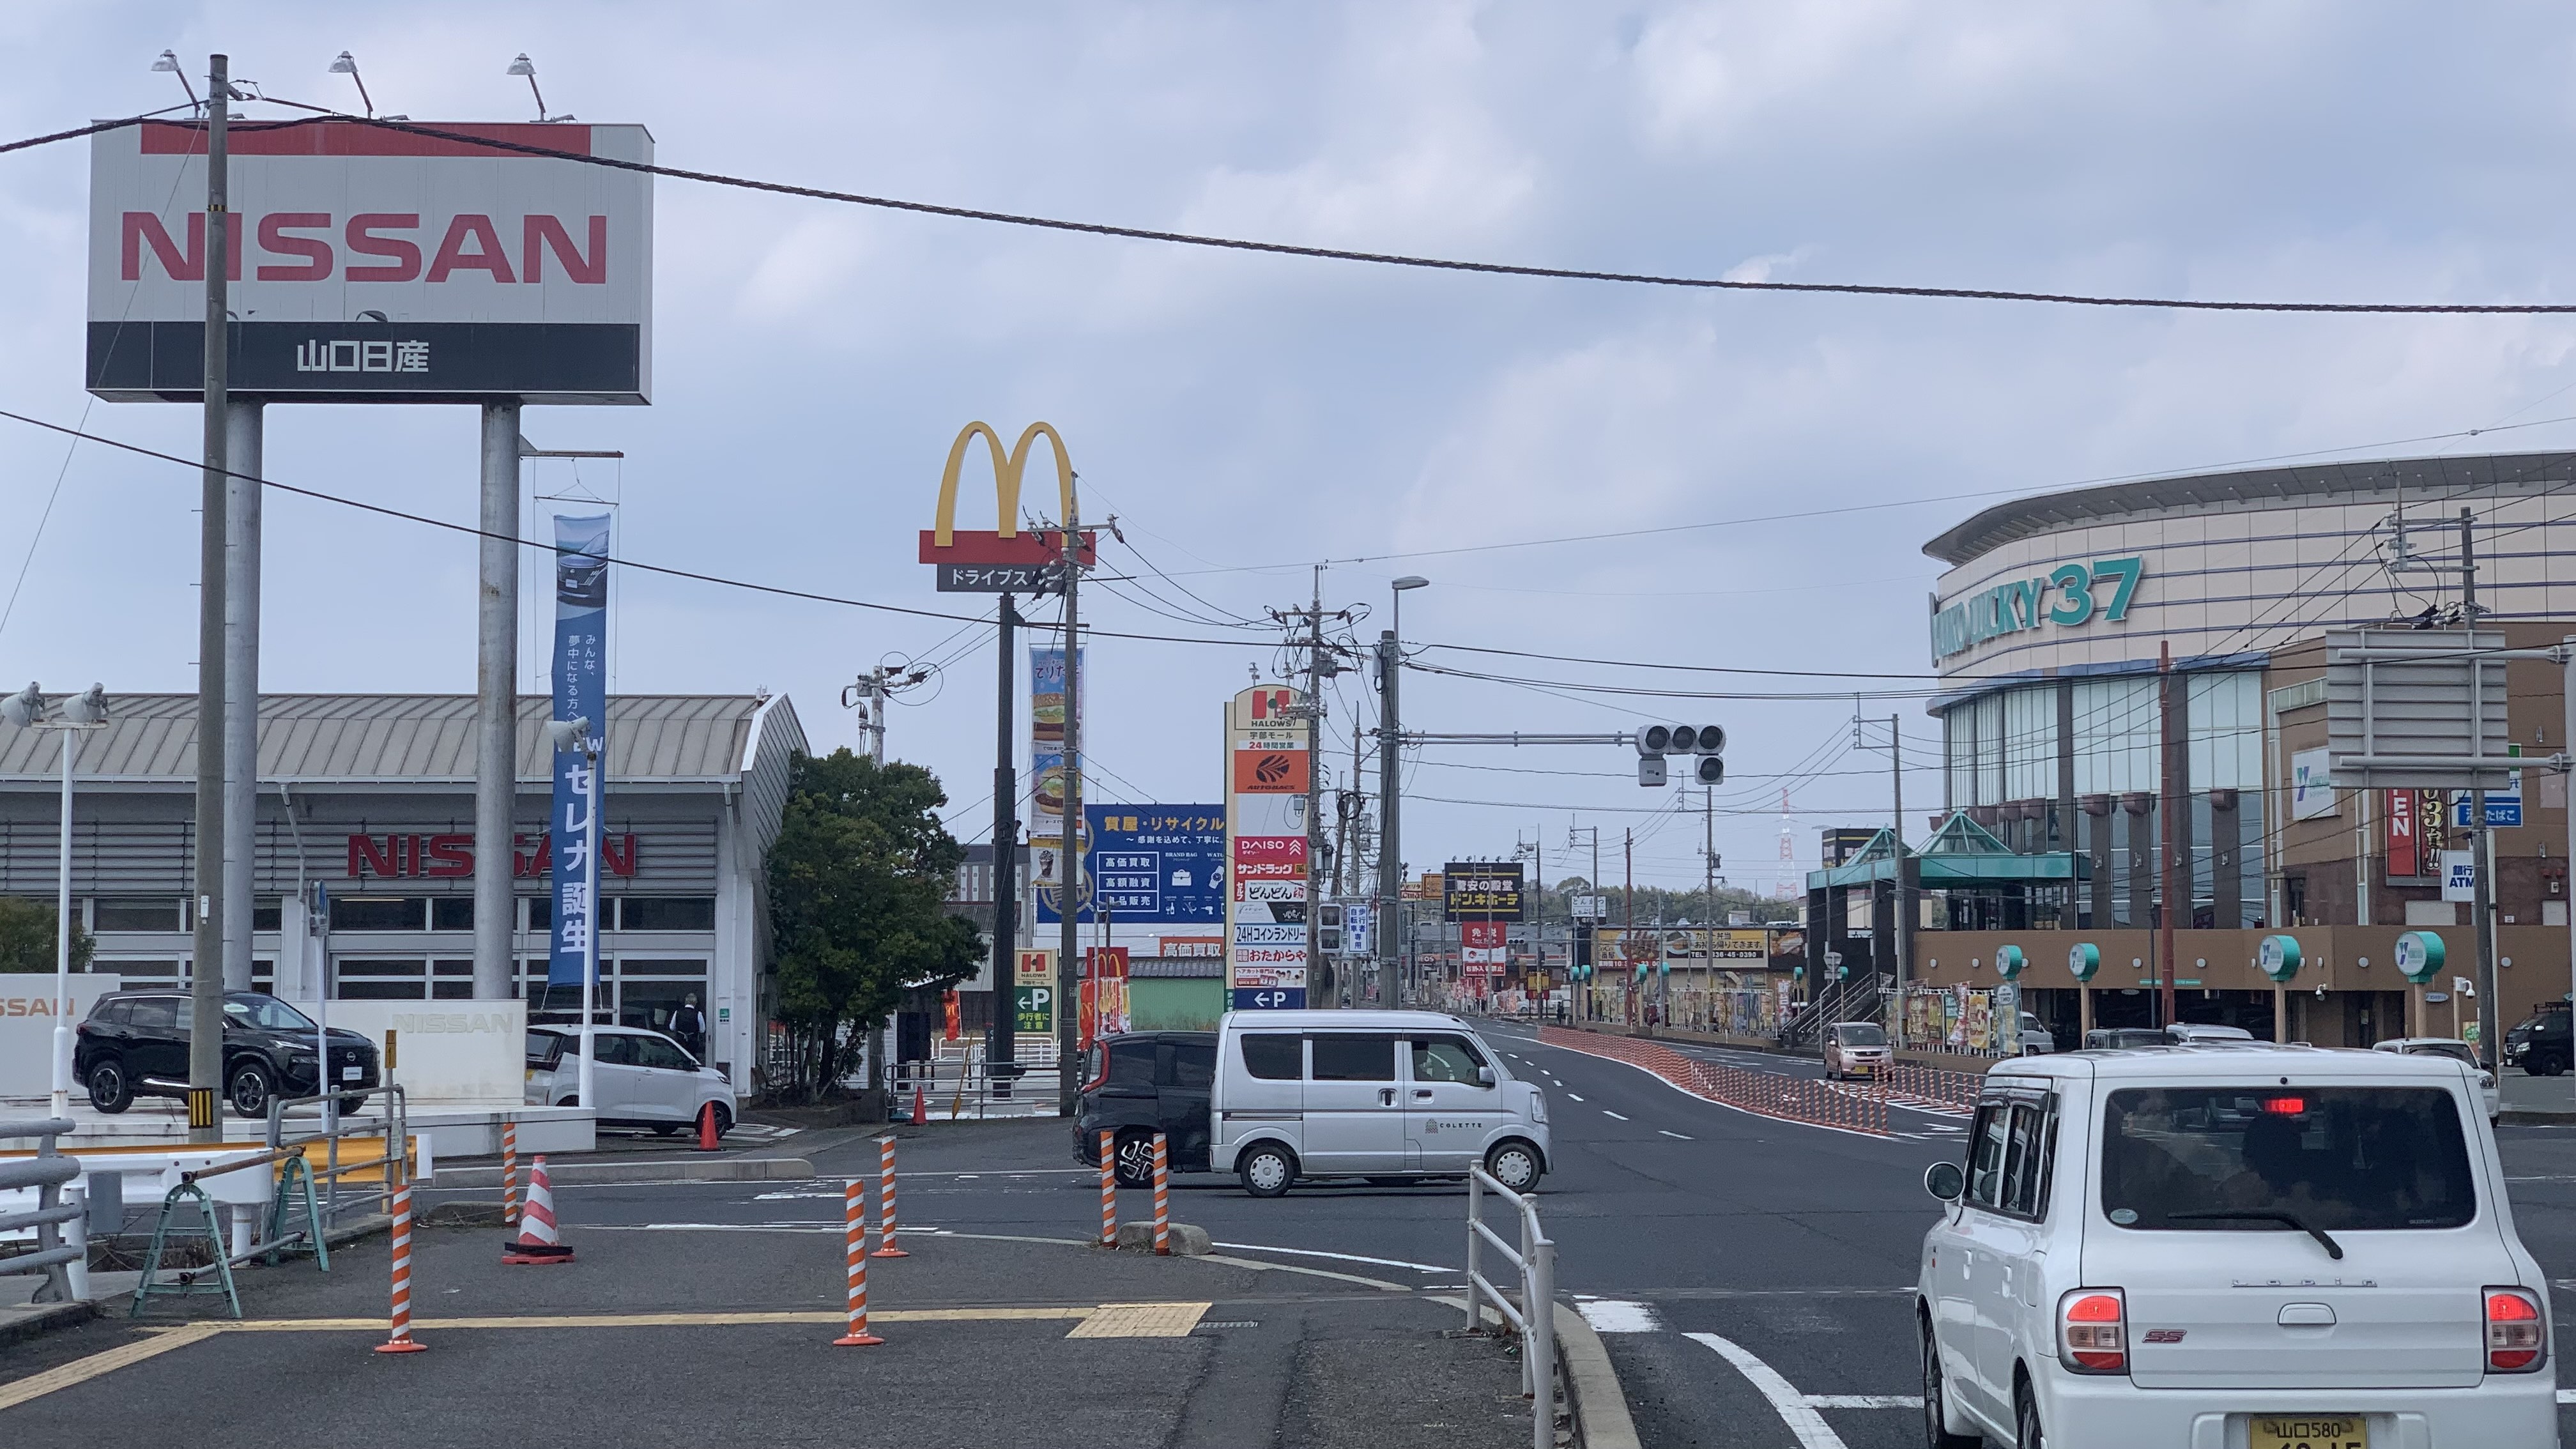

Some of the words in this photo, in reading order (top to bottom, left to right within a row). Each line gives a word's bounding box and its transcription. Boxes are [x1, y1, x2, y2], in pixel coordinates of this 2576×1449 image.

[121, 211, 607, 284] NISSAN
[297, 340, 429, 373] 山口日産
[2049, 554, 2144, 626] 37
[1035, 664, 1080, 679] てりた
[1249, 741, 1294, 749] 24時間営業
[1104, 816, 1225, 831] 質屋・リサイクル
[1241, 840, 1285, 850] DAISO
[348, 834, 636, 877] NISN
[1105, 857, 1151, 868] 高価買取
[1237, 863, 1292, 875] サンドラッグ
[1105, 877, 1151, 888] 高額融資
[2449, 877, 2474, 888] ATM
[1249, 885, 1292, 900] どんどん
[1236, 926, 1307, 942] 24Hコインランドリー
[1163, 943, 1221, 957] 高価買取
[1249, 949, 1307, 963] おたからや
[0, 997, 75, 1016] SAN
[1032, 988, 1050, 1011] P
[1274, 991, 1286, 1008] P
[392, 1013, 513, 1034] NISSAN
[2142, 1328, 2188, 1344] SS
